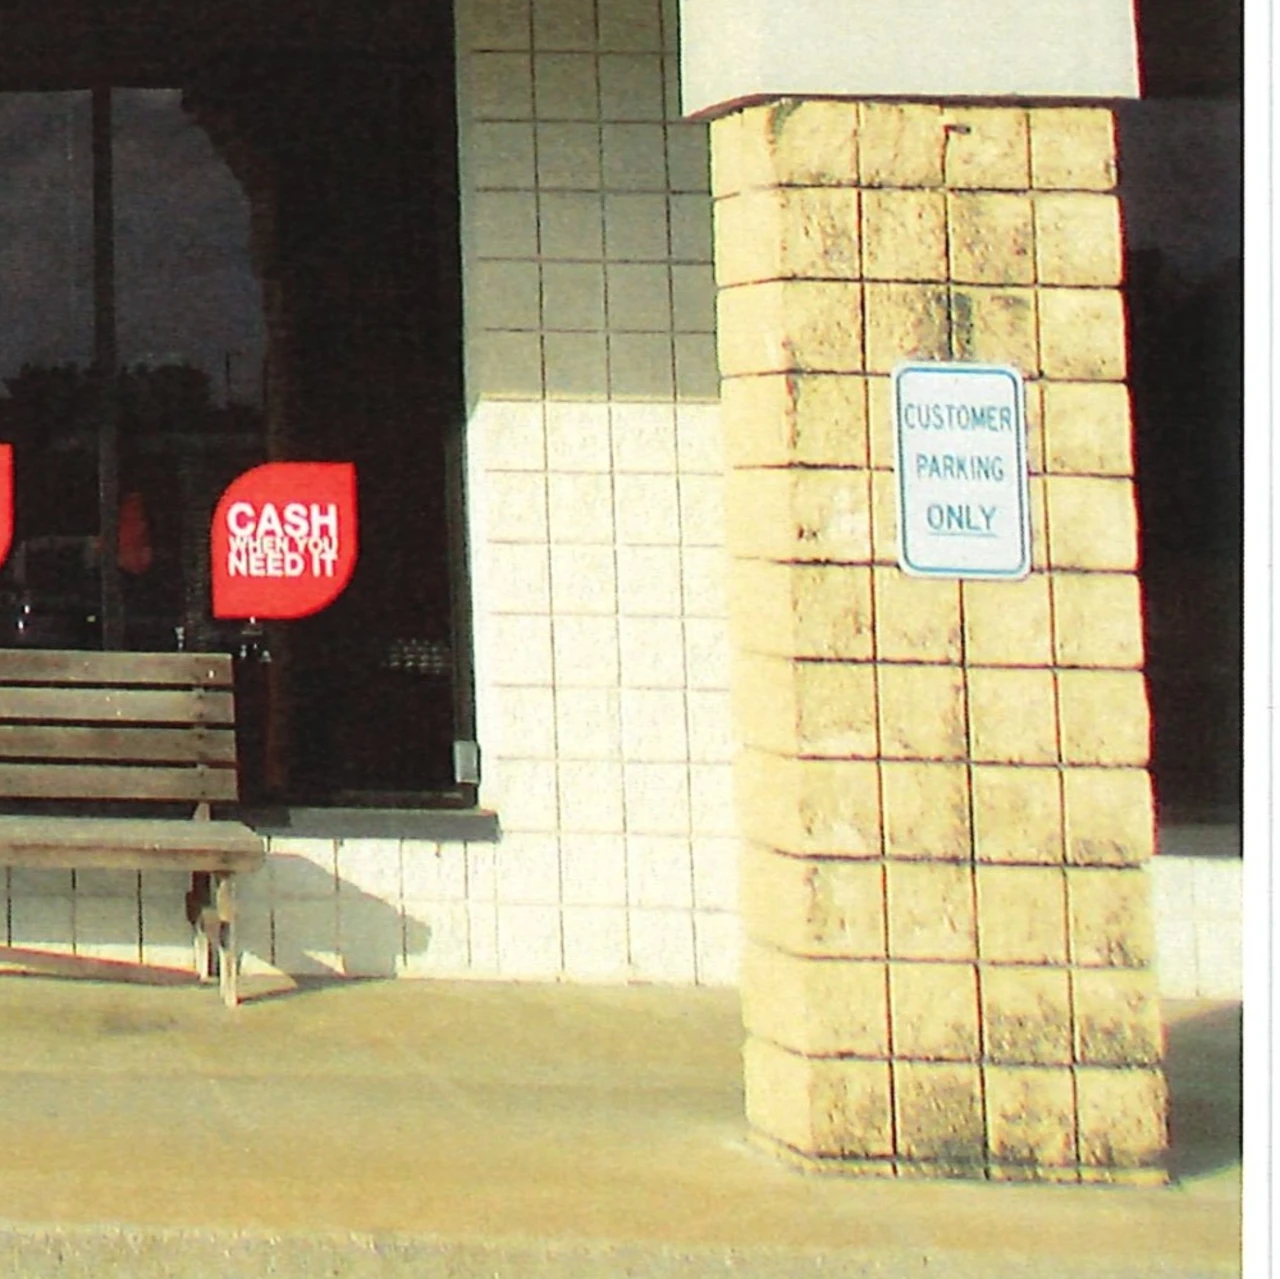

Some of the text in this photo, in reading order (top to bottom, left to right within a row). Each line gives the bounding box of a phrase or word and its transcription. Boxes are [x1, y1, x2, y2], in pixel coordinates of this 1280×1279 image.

[904, 403, 1013, 432] CUSTOMER
[915, 453, 1005, 482] PARKING
[226, 501, 338, 538] CASH
[926, 504, 997, 531] ONLY
[228, 536, 338, 554] WHEN YOU
[228, 551, 337, 578] NEED IT
